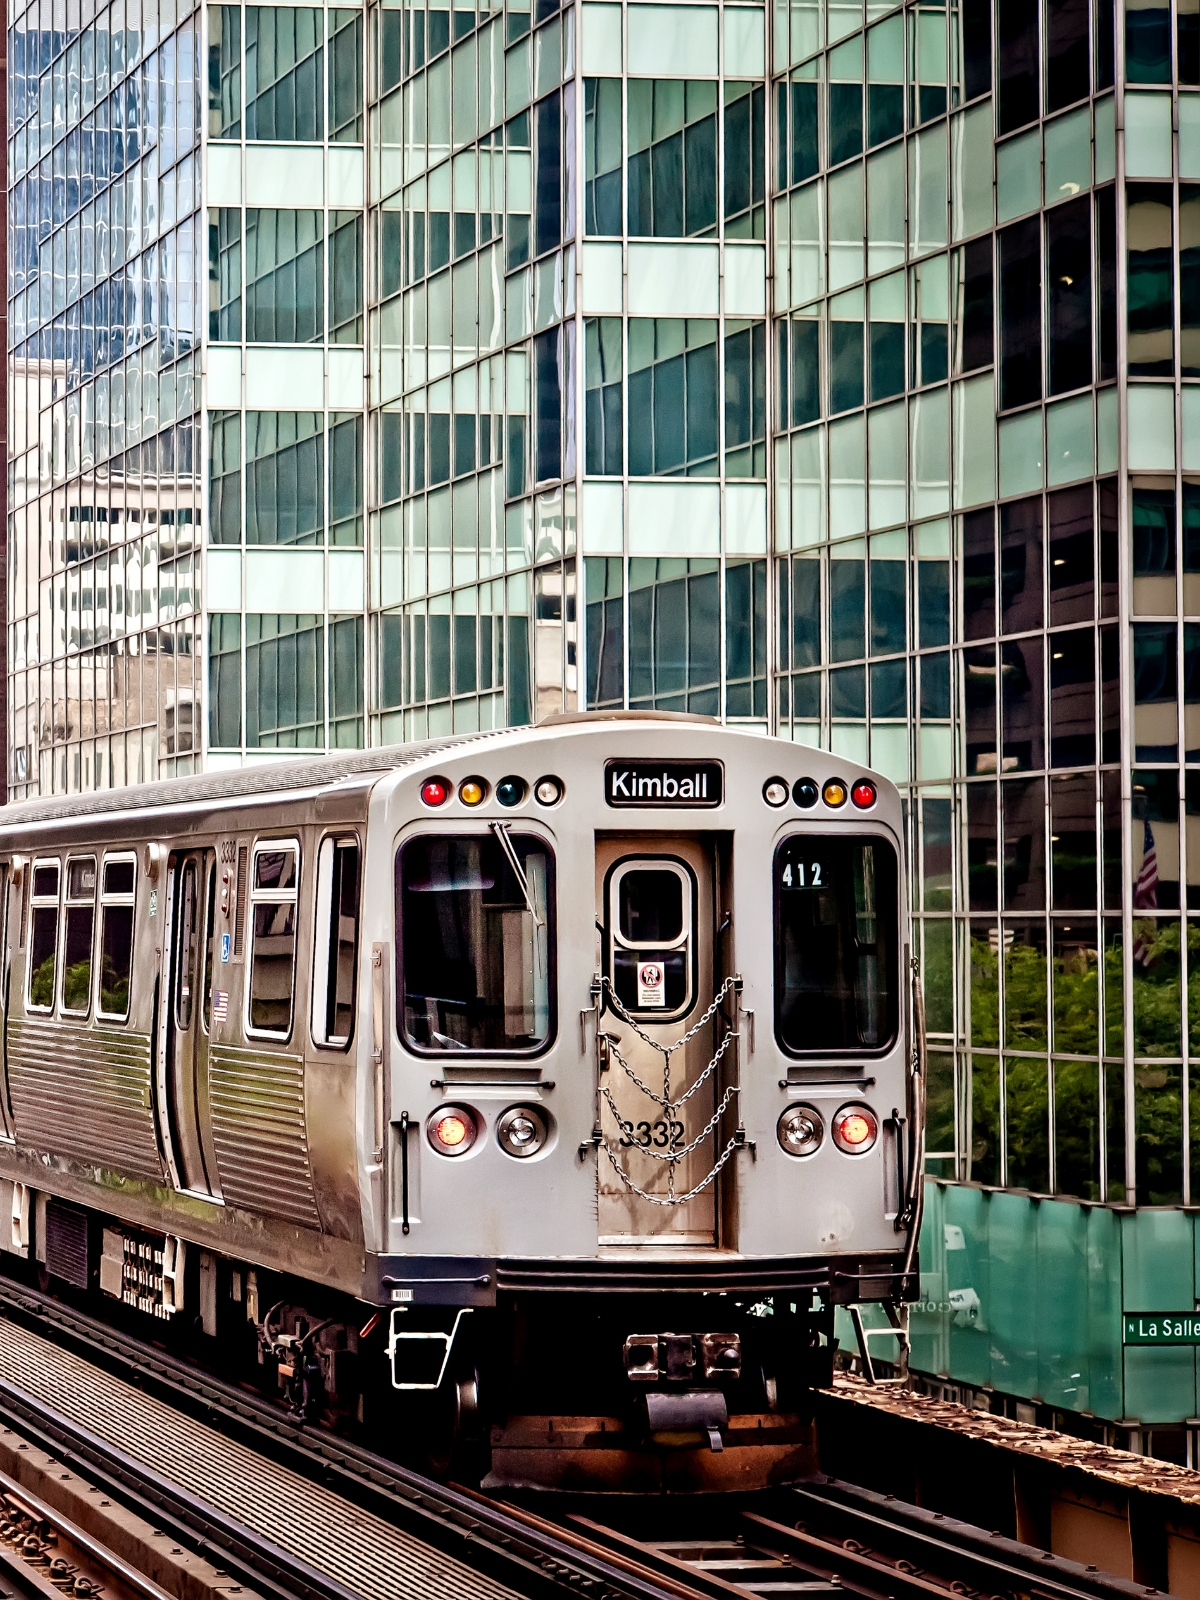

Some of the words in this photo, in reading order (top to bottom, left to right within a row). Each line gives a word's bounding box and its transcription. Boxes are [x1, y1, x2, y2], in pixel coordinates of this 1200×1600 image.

[611, 771, 707, 798] Kimball
[221, 840, 237, 864] 3332
[782, 862, 822, 887] 412
[619, 1120, 686, 1148] 3332
[1128, 1323, 1135, 1333] N
[1139, 1319, 1158, 1337] La
[1162, 1319, 1200, 1337] Salle
